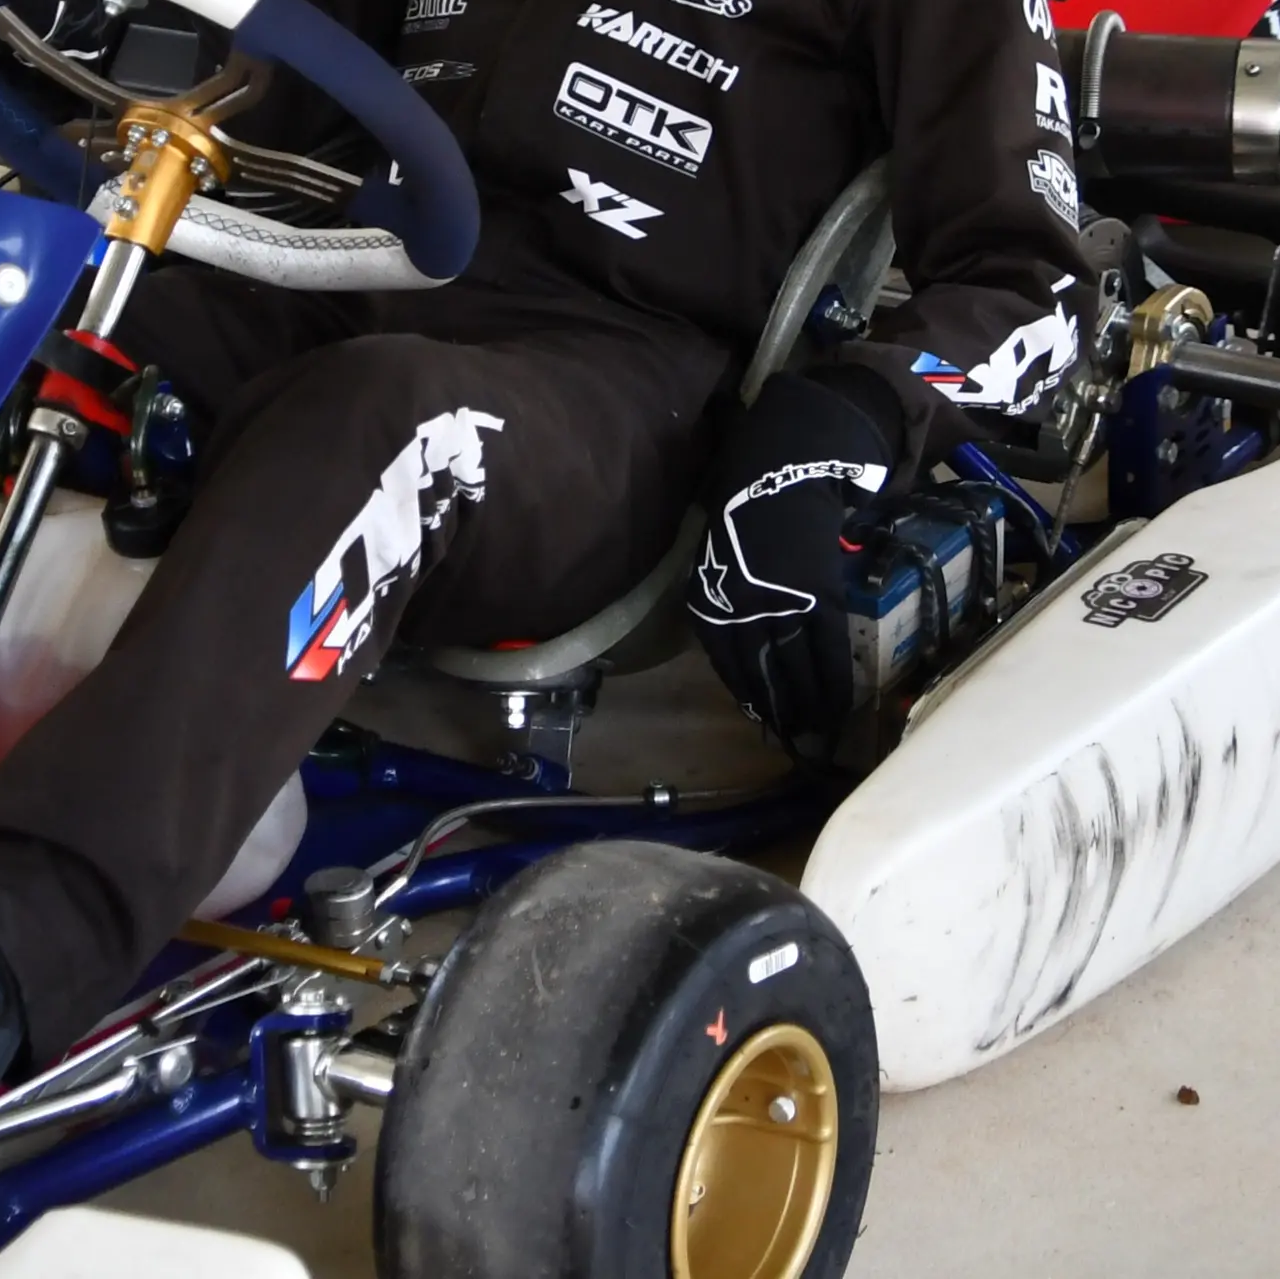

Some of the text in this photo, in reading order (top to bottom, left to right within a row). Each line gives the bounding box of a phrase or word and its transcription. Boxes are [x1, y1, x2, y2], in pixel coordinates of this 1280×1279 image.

[576, 2, 740, 92] KARTECH
[558, 105, 699, 173] KART PARTS
[566, 70, 710, 157] OTK
[1144, 554, 1191, 581] PIC
